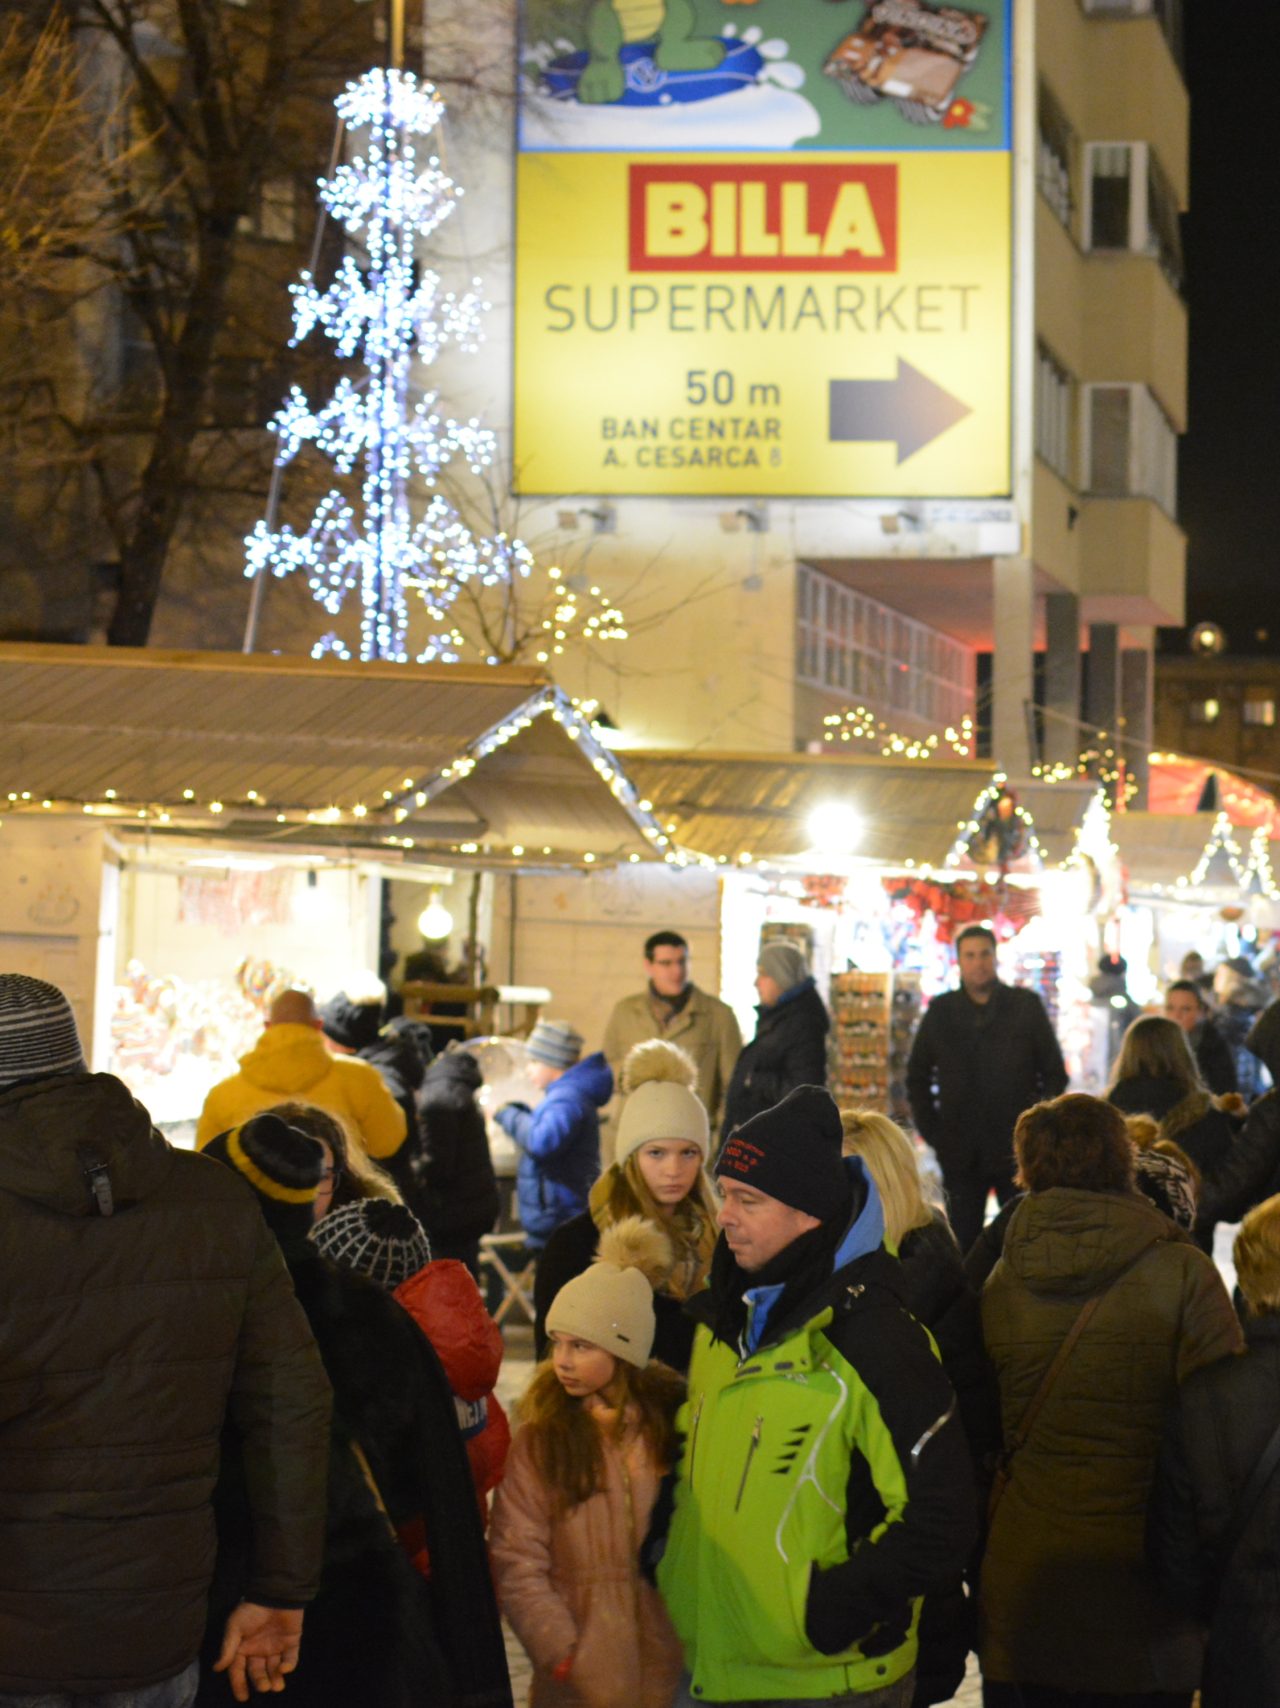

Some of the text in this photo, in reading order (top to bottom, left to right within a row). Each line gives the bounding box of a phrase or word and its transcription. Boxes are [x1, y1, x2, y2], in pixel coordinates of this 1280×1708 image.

[645, 181, 886, 258] BILLA
[545, 285, 980, 332] SUPERMARKET
[687, 370, 781, 405] 50 m
[602, 417, 782, 440] BAN CENTAR
[603, 448, 627, 468] A.
[636, 446, 760, 469] CESARCA
